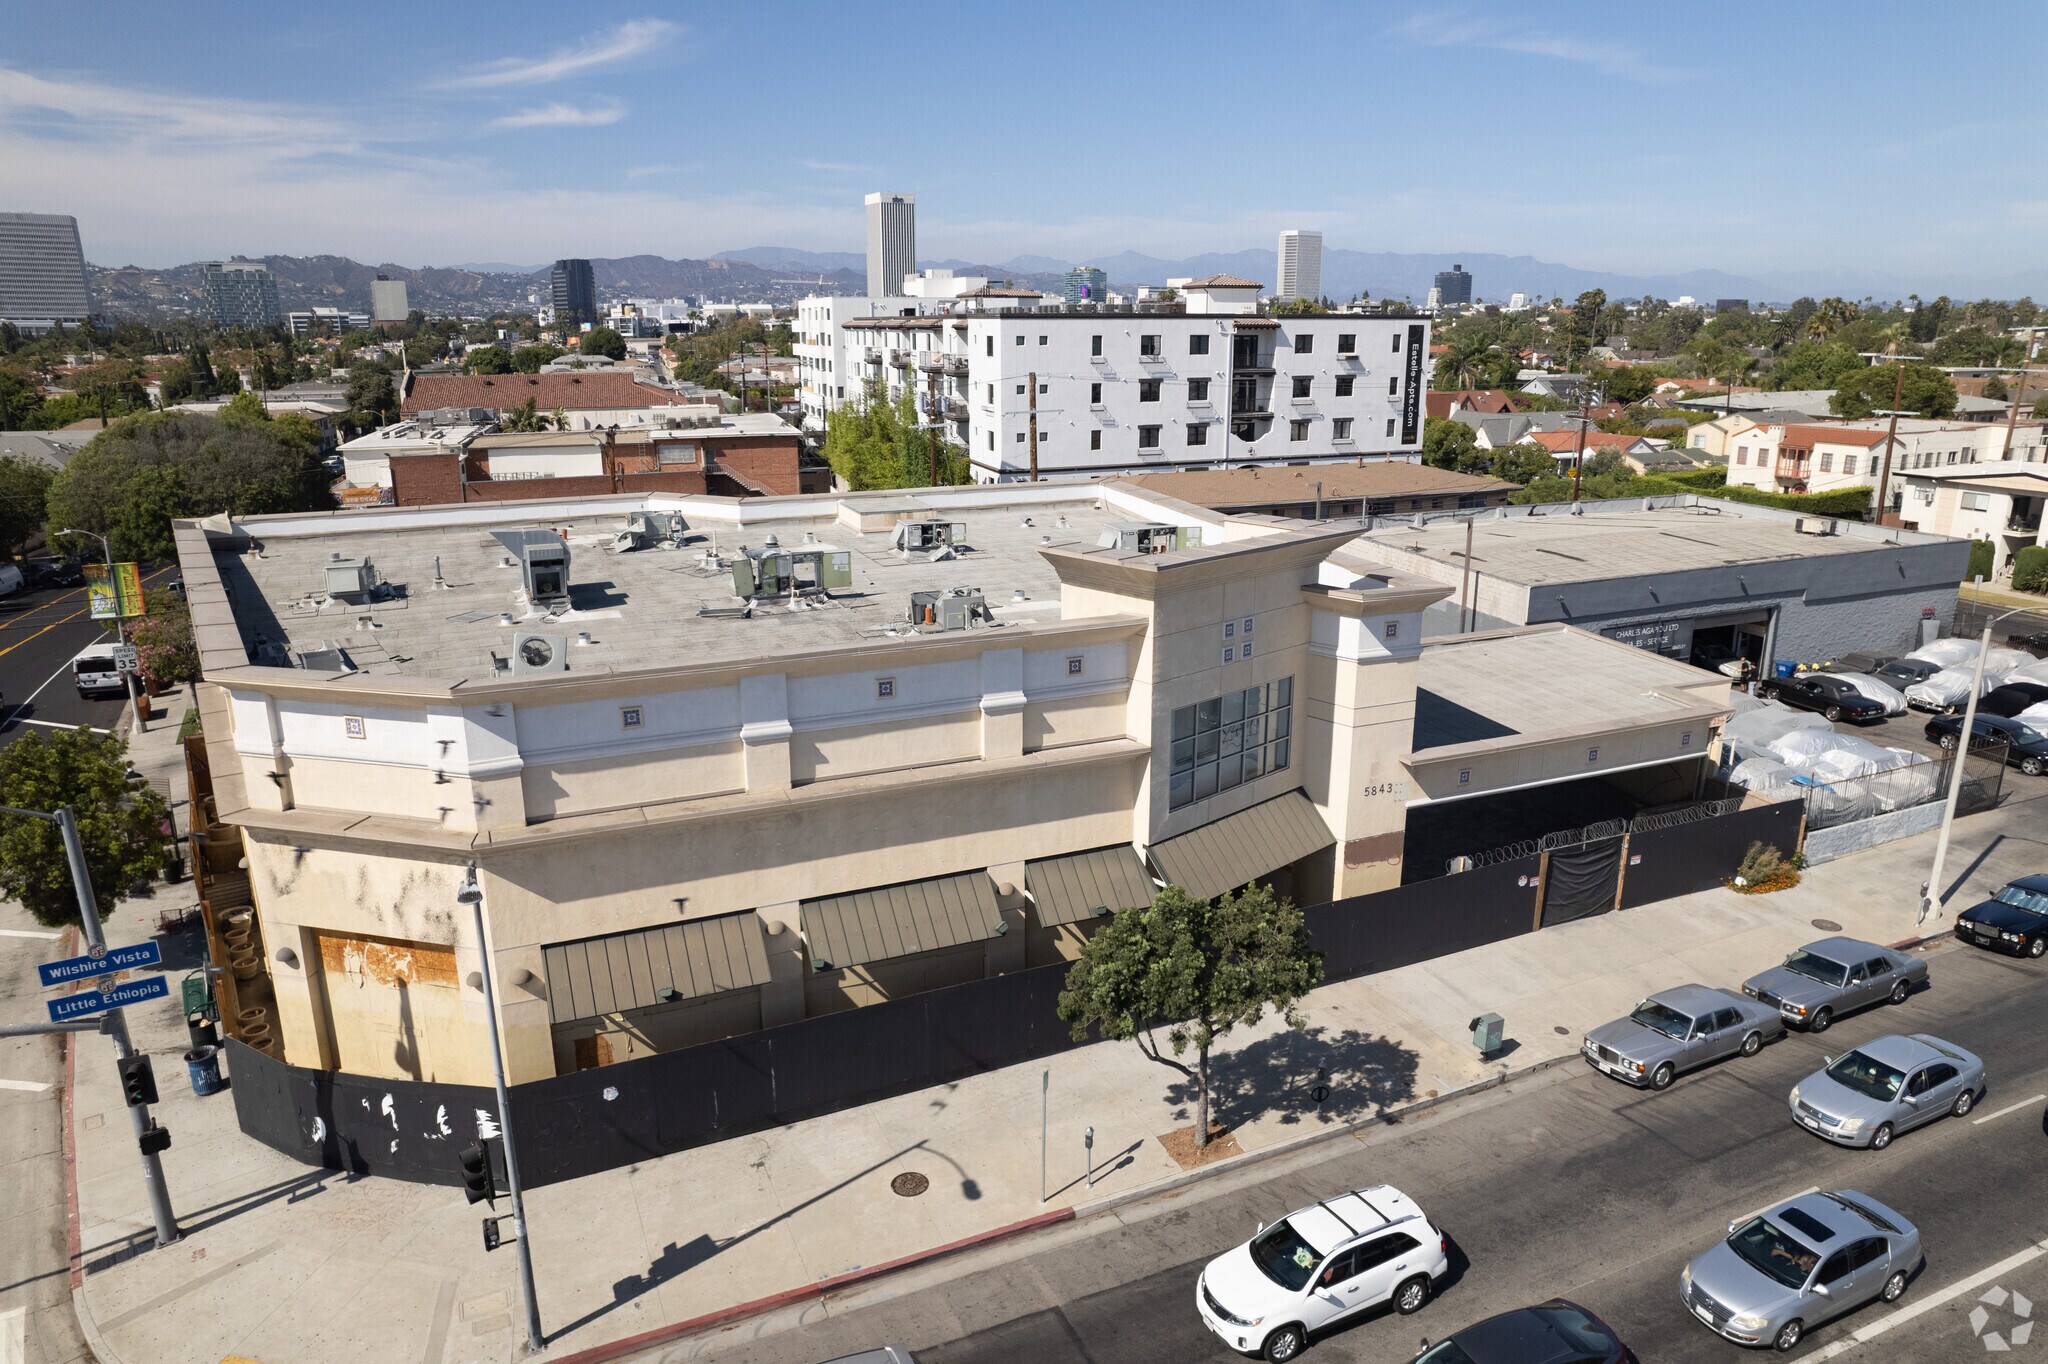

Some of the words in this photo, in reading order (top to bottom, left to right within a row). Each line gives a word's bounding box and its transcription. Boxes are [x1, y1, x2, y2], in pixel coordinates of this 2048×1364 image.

[1407, 343, 1419, 427] Estelle-Apts.com
[1627, 639, 1643, 648] SAES
[1647, 636, 1669, 646] SERCE
[118, 659, 137, 669] 35
[1364, 782, 1393, 797] 5843
[49, 959, 107, 979] Wilshire
[112, 950, 150, 965] Vista
[57, 998, 97, 1014] Little
[102, 984, 161, 1004] Ethiopia
